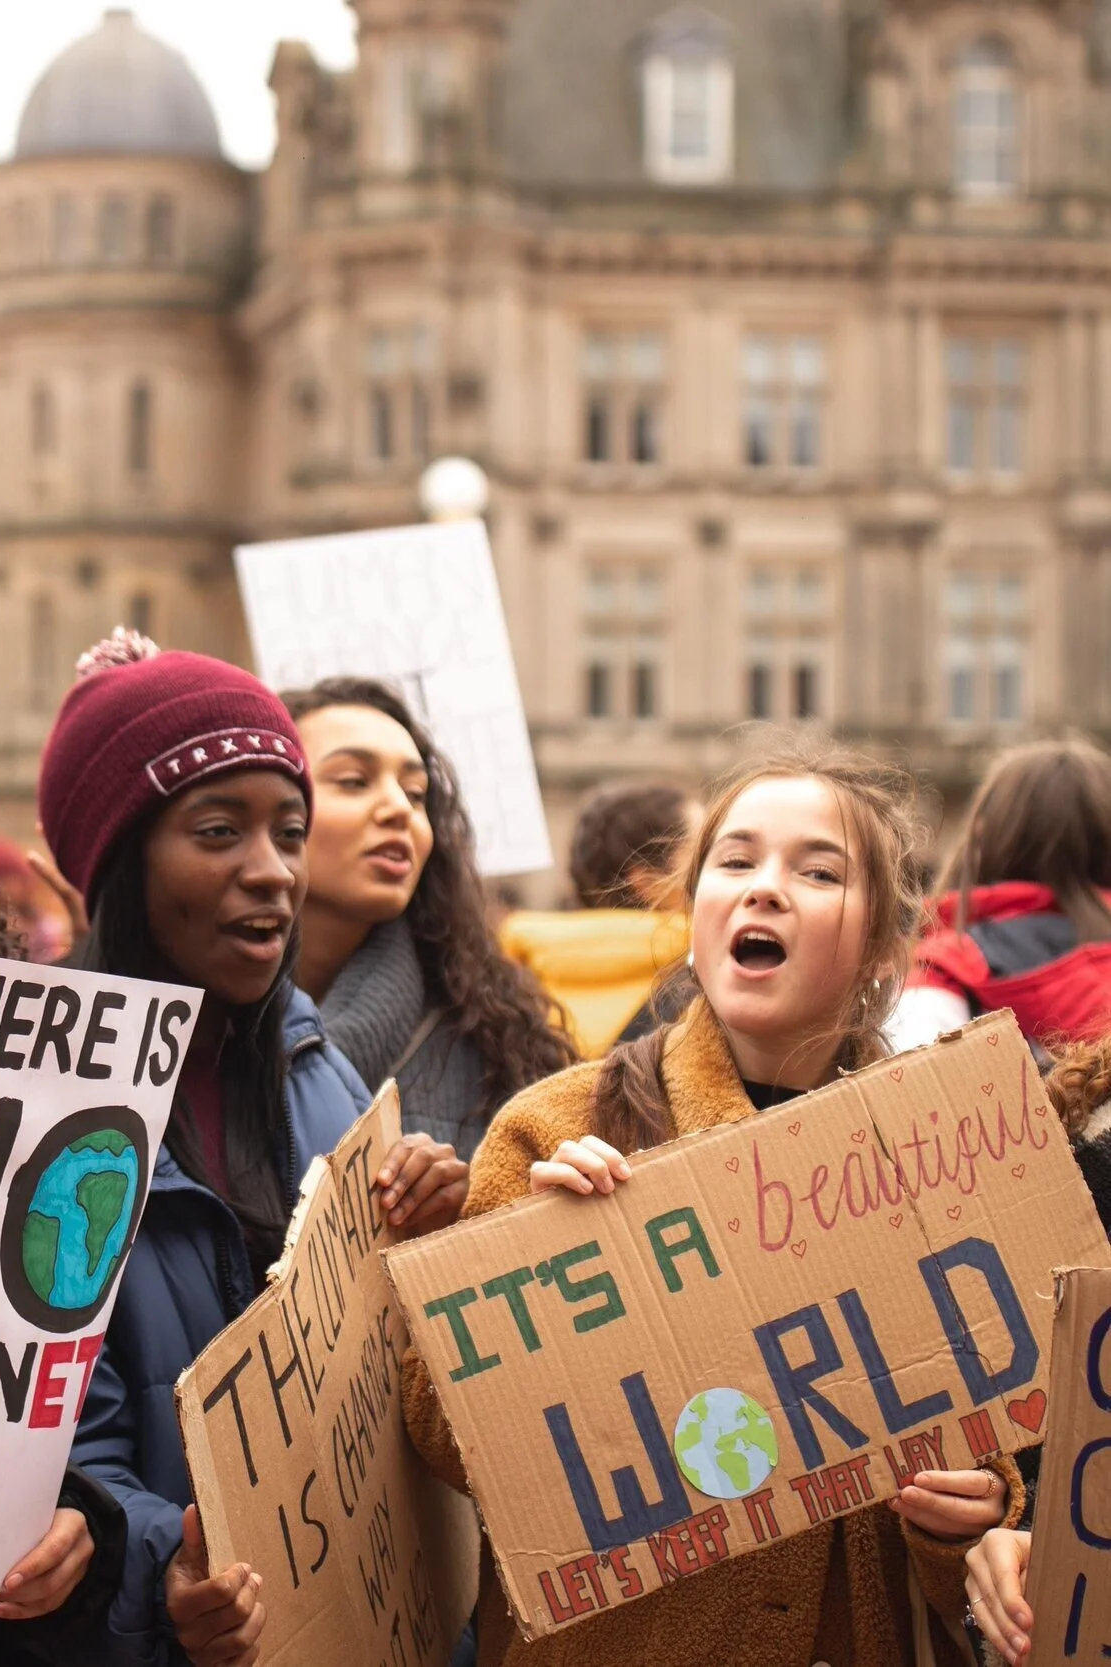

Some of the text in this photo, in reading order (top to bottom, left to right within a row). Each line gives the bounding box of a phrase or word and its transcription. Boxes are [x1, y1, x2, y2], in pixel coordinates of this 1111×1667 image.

[132, 996, 192, 1087] IS
[202, 1135, 384, 1488] THE CLIMATE
[424, 1053, 1049, 1383] IT'S A beautiful
[542, 1236, 1041, 1555] WORLD
[278, 1470, 330, 1589] IS
[357, 1483, 398, 1627] WHY
[536, 1547, 644, 1625] LET'S
[646, 1503, 730, 1584] KEEP
[742, 1488, 782, 1544] IT
[789, 1454, 875, 1525] THAT
[882, 1425, 949, 1490] WAY
